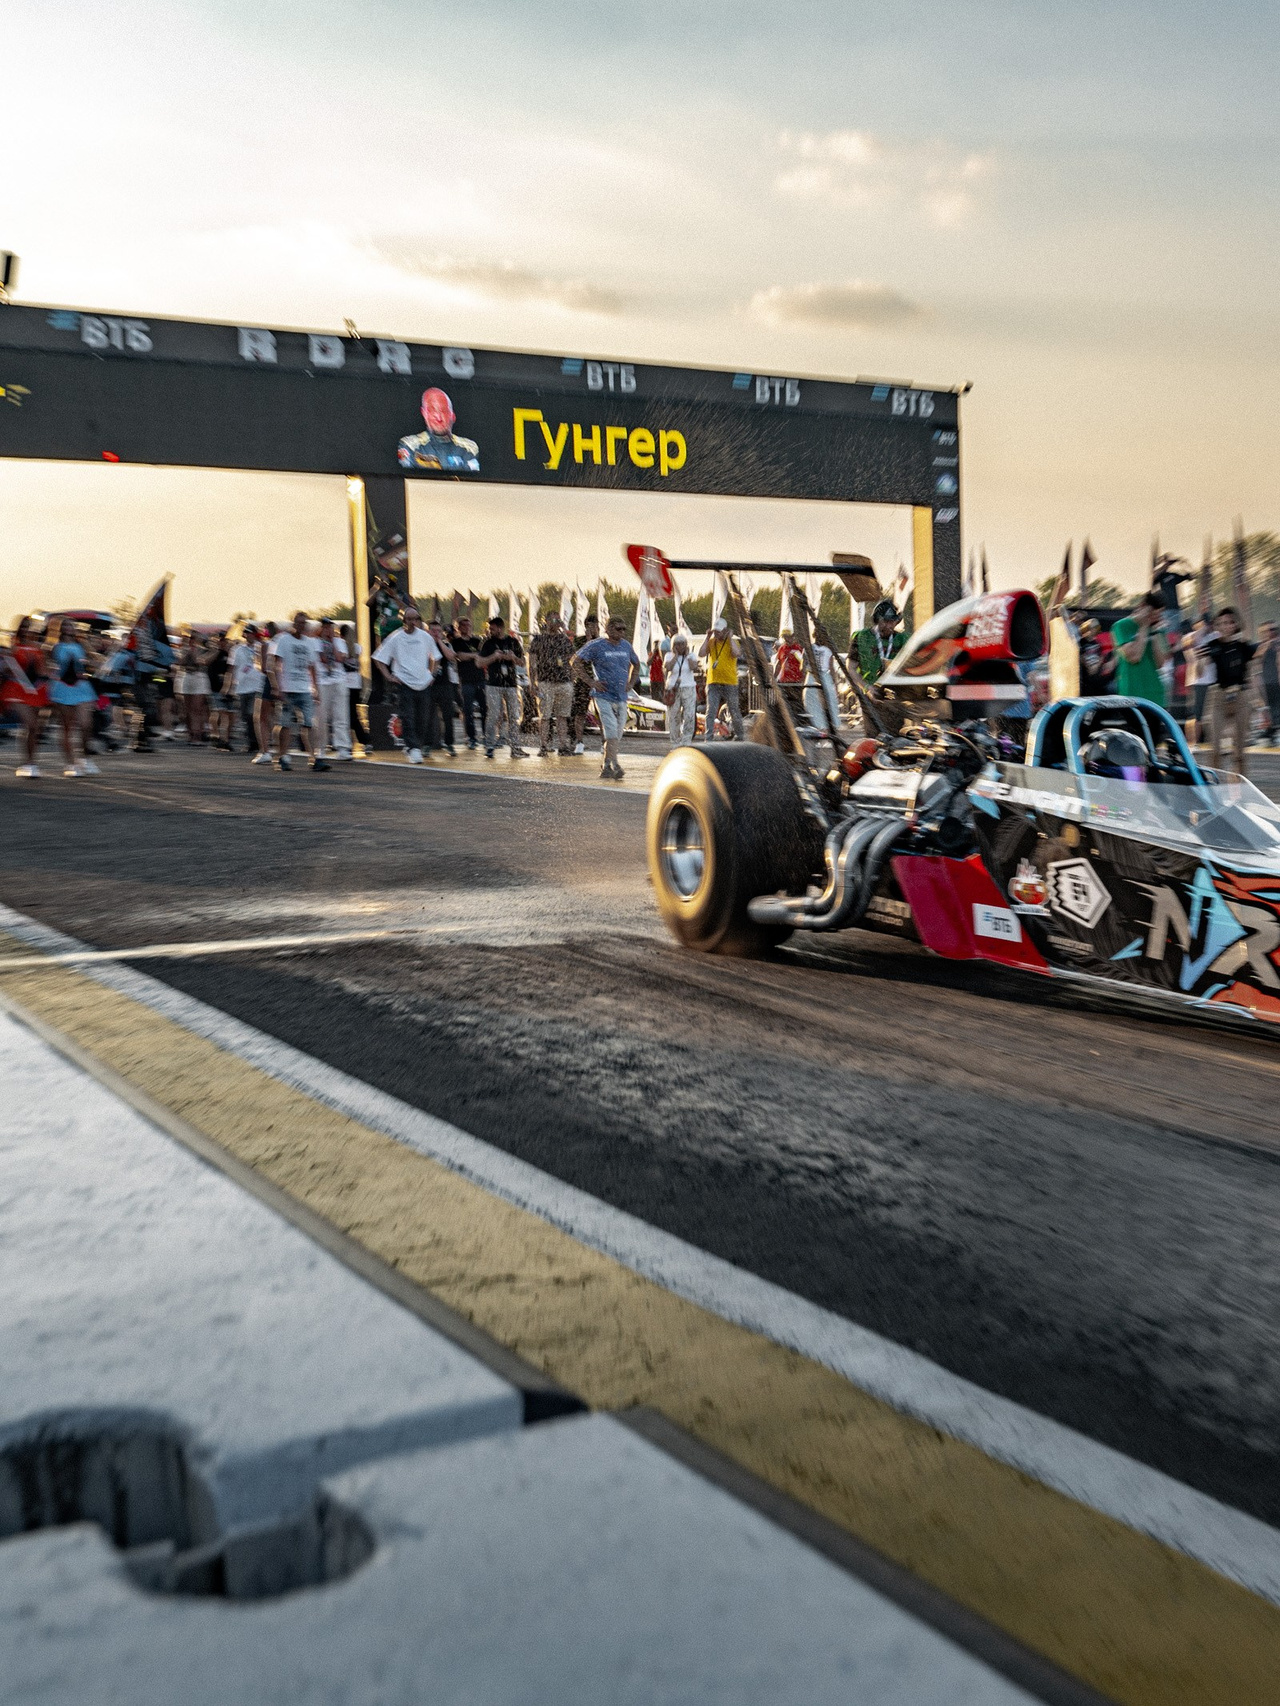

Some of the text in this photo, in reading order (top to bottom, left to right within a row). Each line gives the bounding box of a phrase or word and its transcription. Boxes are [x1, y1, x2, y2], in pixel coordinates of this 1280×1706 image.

[586, 361, 637, 394] ВТБ
[755, 375, 800, 407] ВТБ
[891, 388, 935, 418] ВТБ
[513, 407, 687, 476] Гунгер
